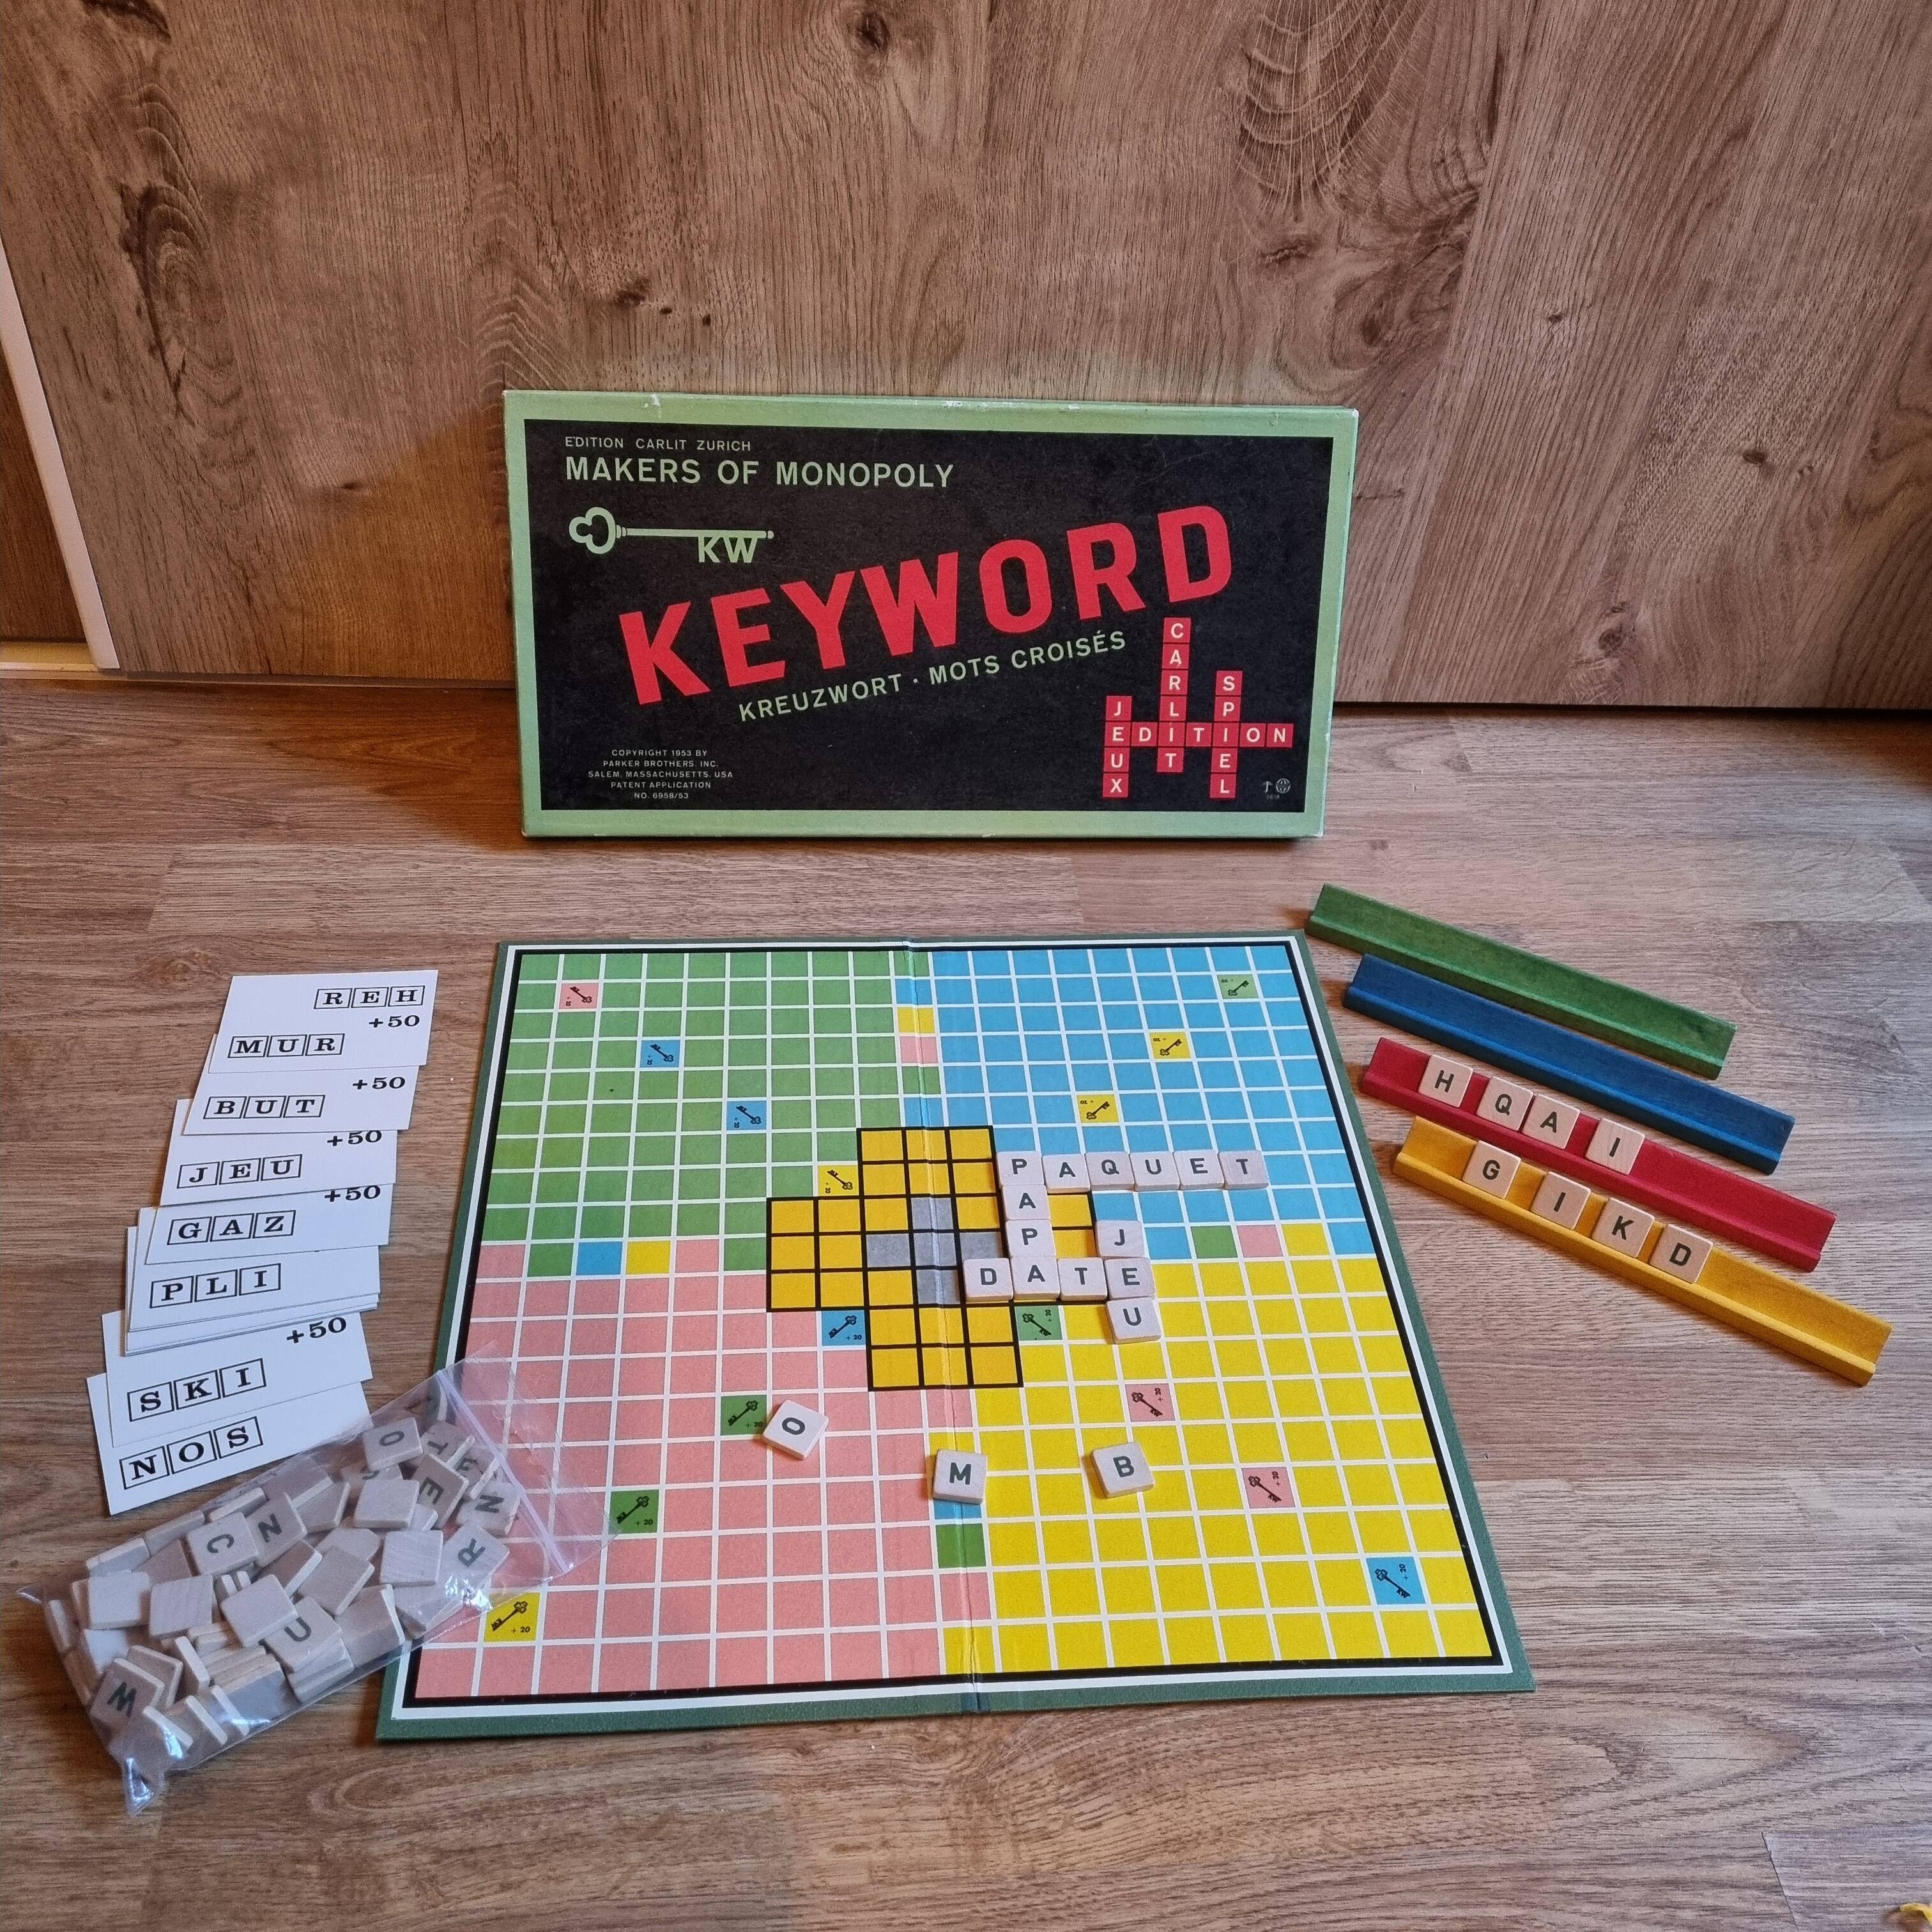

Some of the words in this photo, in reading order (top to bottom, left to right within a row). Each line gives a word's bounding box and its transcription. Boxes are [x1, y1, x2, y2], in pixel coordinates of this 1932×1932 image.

[565, 436, 623, 448] EDITION
[636, 438, 686, 450] CARLIT
[697, 440, 750, 451] ZURICH
[567, 457, 700, 483] MAKERS
[718, 460, 758, 484] OF
[777, 462, 953, 487] MONOPOLY
[698, 535, 758, 564] KW
[619, 506, 1232, 705] KEYWORD
[739, 674, 901, 721] KREUZWORT
[930, 656, 999, 684] MOTS
[1011, 631, 1125, 668] CROISÉS
[1164, 622, 1184, 768] CARLIT
[1109, 703, 1124, 793] JEUX
[1112, 727, 1287, 742] EDITION
[1218, 676, 1236, 794] SPIEL
[323, 989, 417, 1005] REH
[368, 1015, 420, 1028] +50
[234, 1038, 335, 1054] MUR
[352, 1077, 406, 1090] +50
[215, 1099, 314, 1115] BUT
[1434, 1070, 1455, 1092] H
[1495, 1094, 1512, 1115] Q
[1541, 1112, 1558, 1133] A
[1609, 1138, 1620, 1157] I
[188, 1160, 295, 1183] JEU
[1011, 1158, 1249, 1177] PAQUET
[178, 1216, 285, 1238] GAZ
[1011, 1158, 1045, 1283] PAPA
[1482, 1160, 1499, 1180] G
[1554, 1192, 1566, 1213] I
[1612, 1215, 1634, 1240] K
[1669, 1243, 1691, 1267] D
[161, 1270, 267, 1301] PLI
[981, 1265, 1140, 1285] DATE
[1114, 1229, 1142, 1326] JEU
[286, 1316, 347, 1344] +50
[139, 1367, 251, 1413] SKI
[782, 1416, 806, 1436] O
[129, 1427, 250, 1480] NOS
[1112, 1455, 1135, 1478] B
[949, 1462, 972, 1485] M
[206, 1535, 234, 1554] C
[457, 1538, 486, 1567] R
[284, 1616, 312, 1642] U
